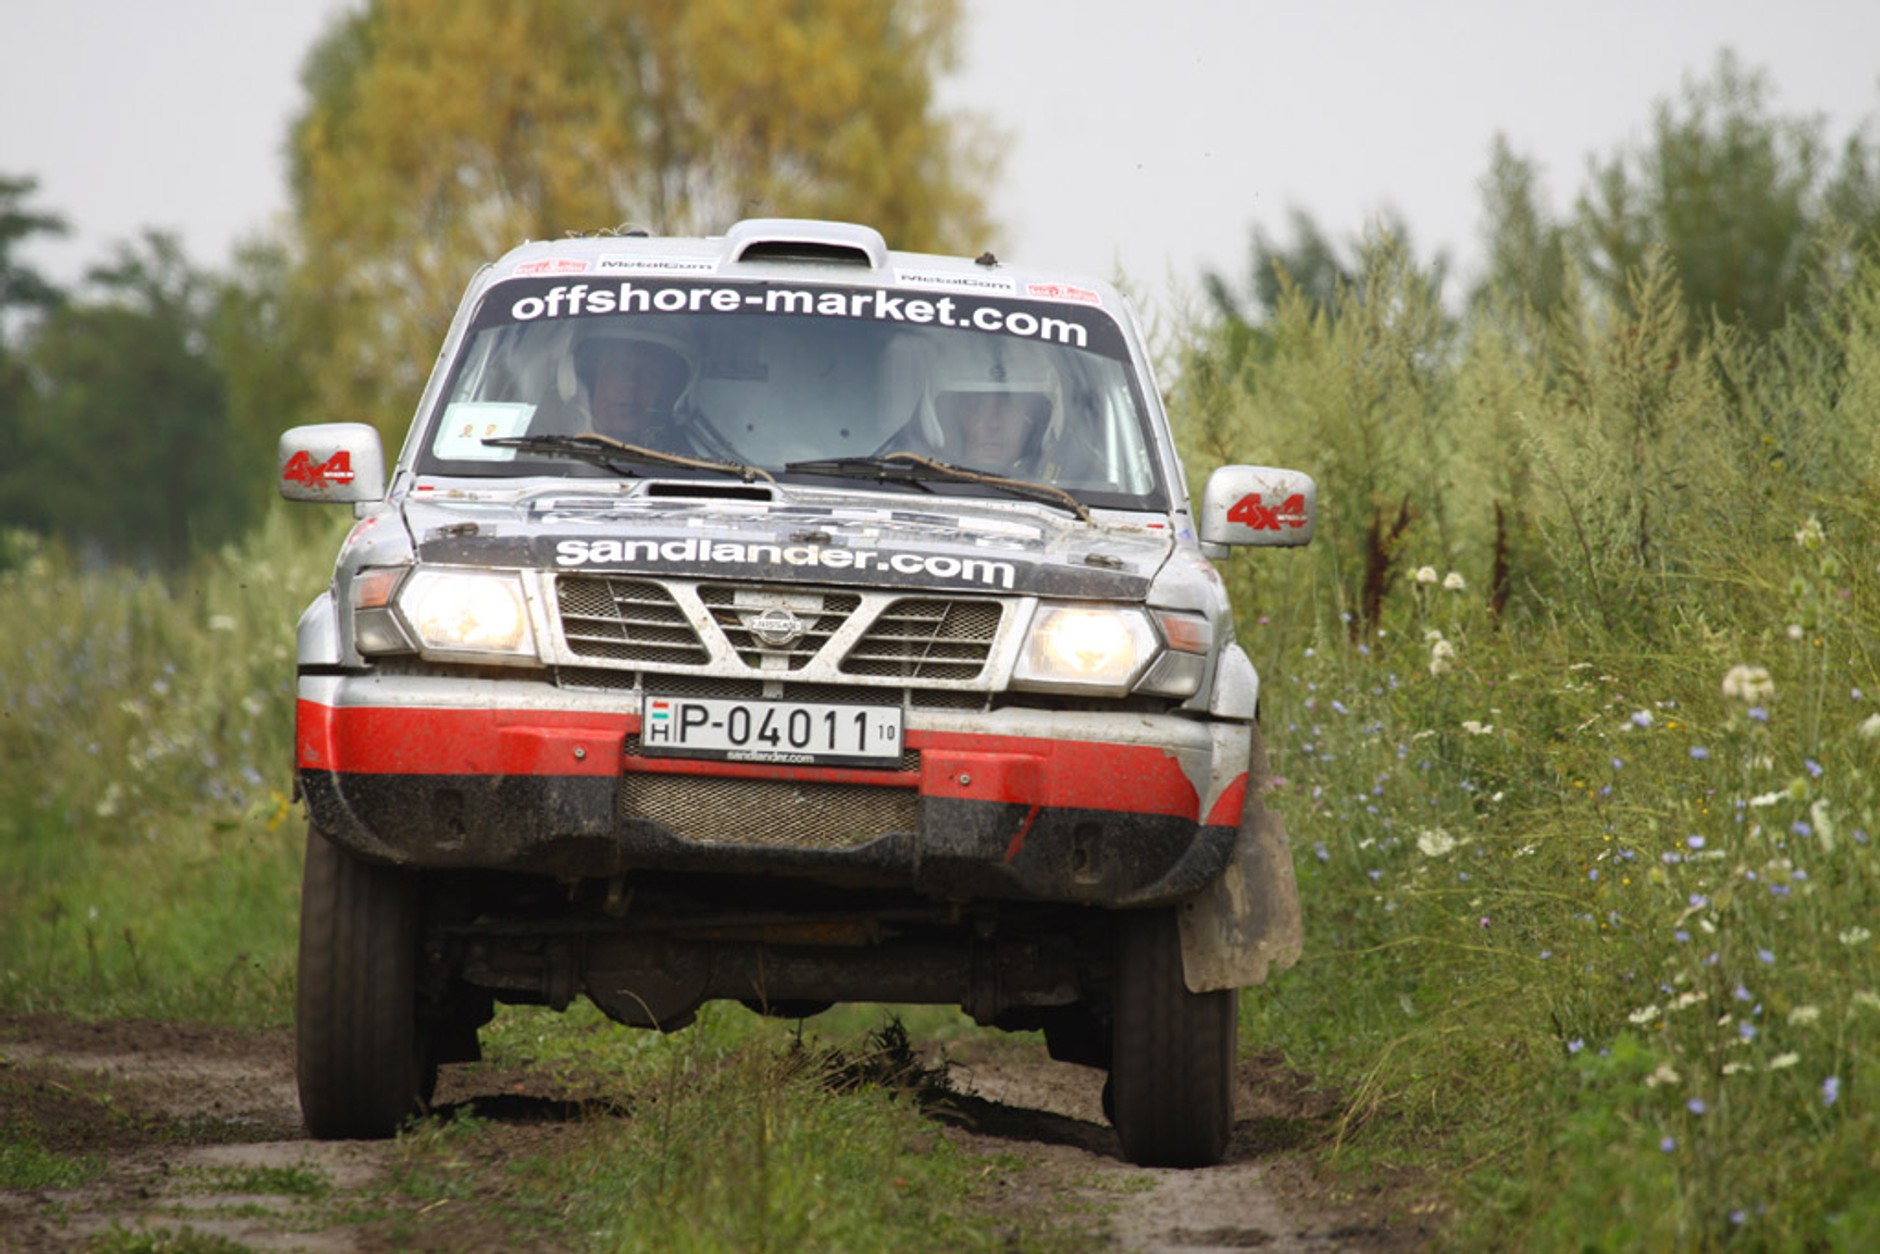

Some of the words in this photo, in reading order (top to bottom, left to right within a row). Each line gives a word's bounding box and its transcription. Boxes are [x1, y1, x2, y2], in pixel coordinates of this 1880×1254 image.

[511, 282, 1088, 348] offshore-market.com
[554, 538, 1017, 589] sandlander.com
[650, 723, 669, 743] H
[679, 703, 868, 752] P-04011
[878, 724, 896, 741] 10
[726, 750, 815, 764] sandlander.com
